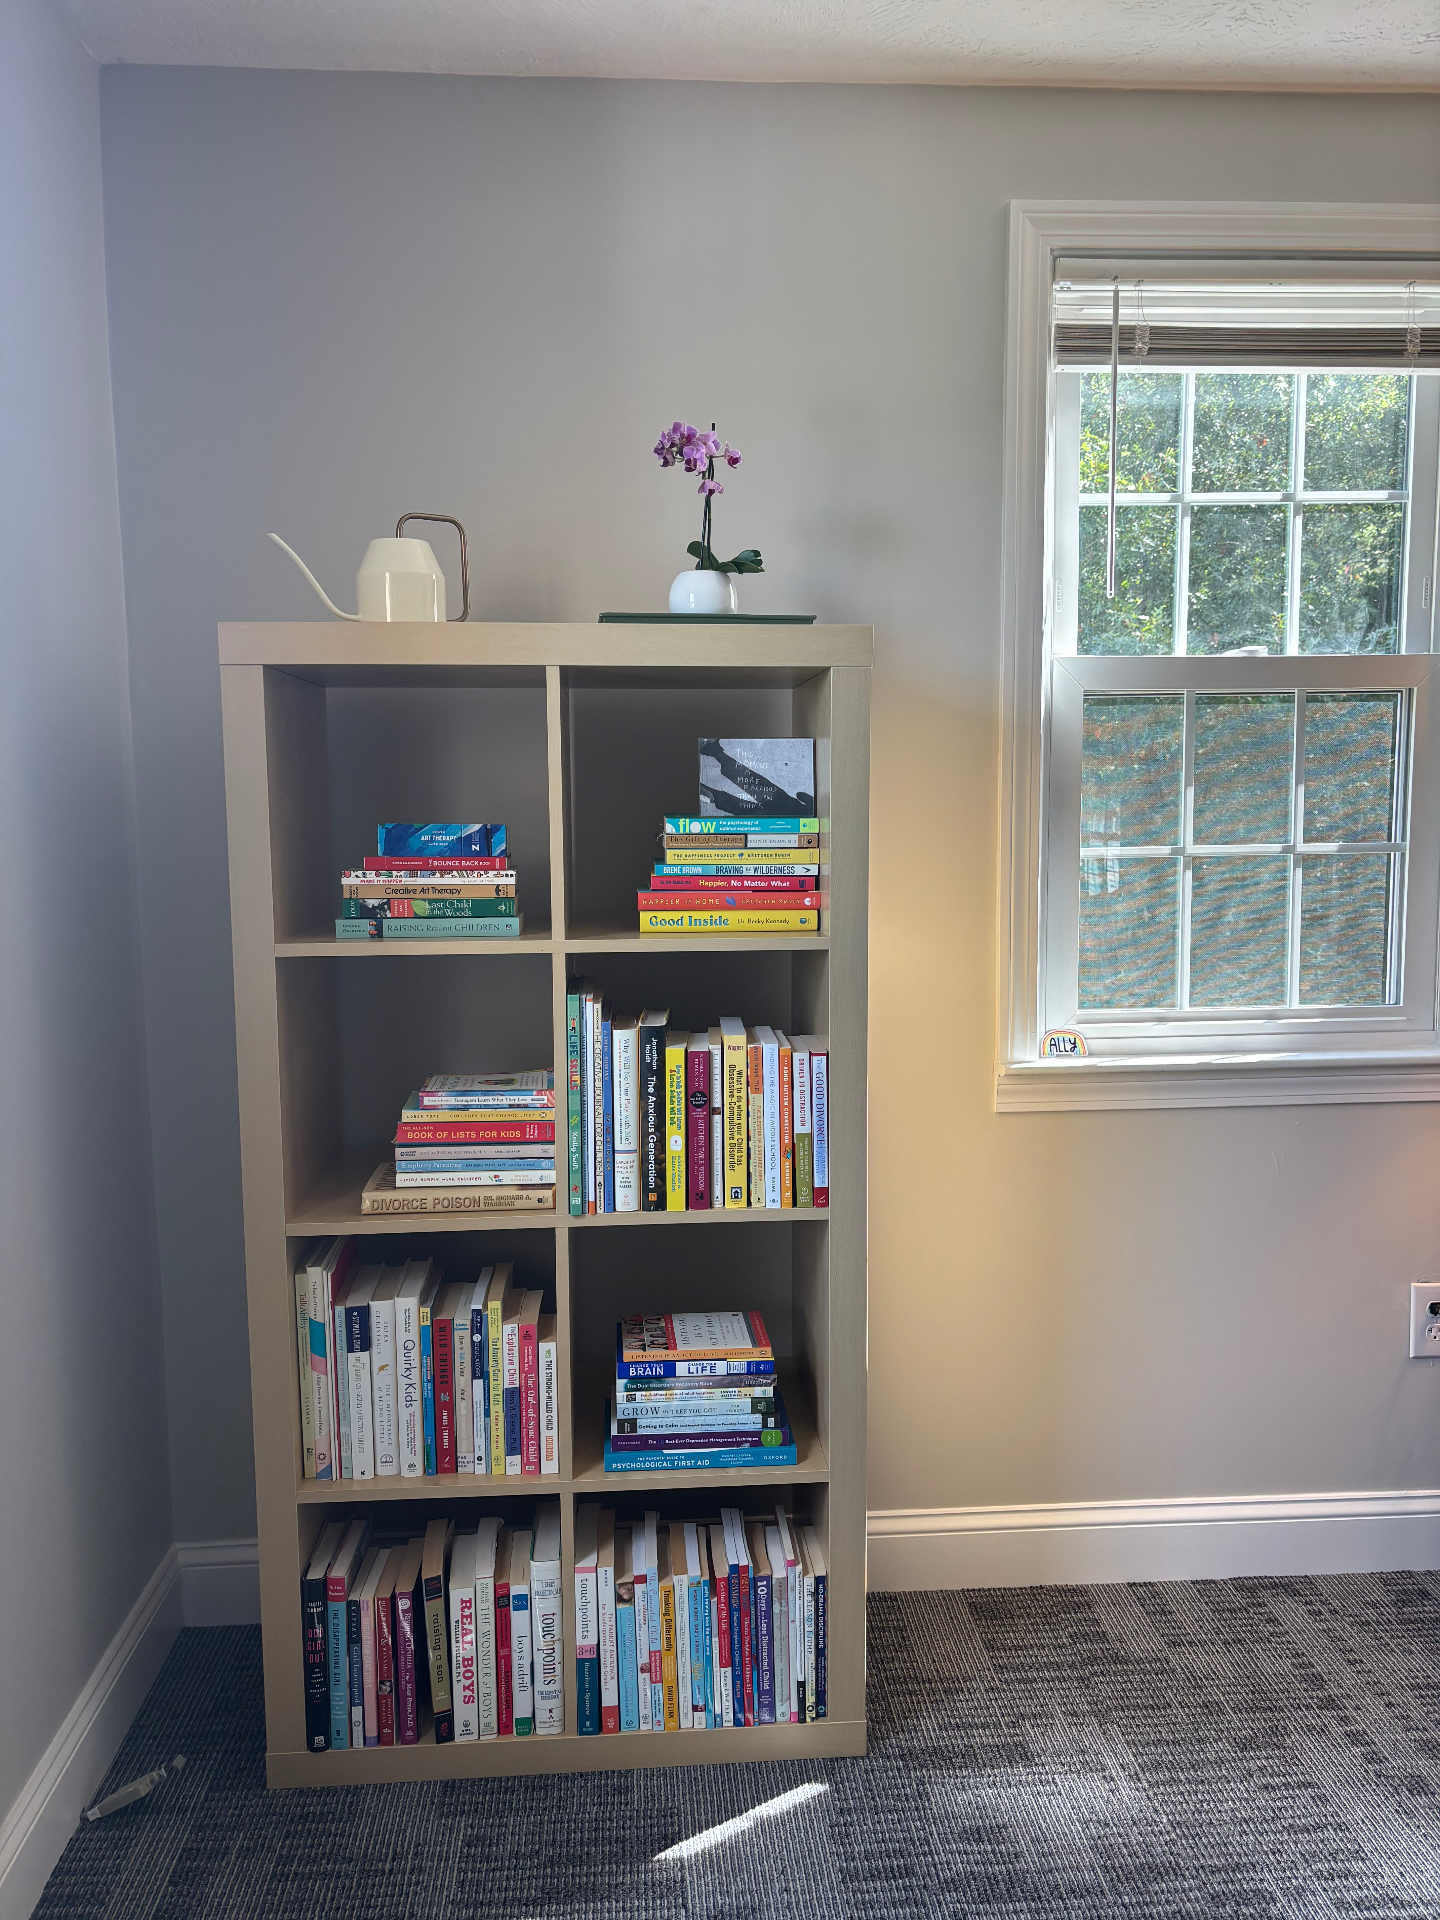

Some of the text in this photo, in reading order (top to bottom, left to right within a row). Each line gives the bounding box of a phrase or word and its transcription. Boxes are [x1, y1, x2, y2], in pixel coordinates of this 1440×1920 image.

[678, 819, 716, 833] flow
[716, 866, 795, 874] BRAVING WILDERNESS
[445, 909, 472, 917] Woods
[447, 900, 472, 908] Child
[455, 924, 500, 932] CHILDREN
[650, 916, 729, 926] Good Inside
[622, 1039, 630, 1053] Why
[569, 1034, 579, 1090] LIFE SKILLS
[624, 1072, 630, 1081] No
[815, 1072, 824, 1100] GOOD
[728, 1064, 737, 1172] Obsessive-Compulsive Disorder
[770, 1111, 776, 1119] IN
[816, 1103, 825, 1145] DIVORCE
[647, 1076, 656, 1188] The Anxious Generation
[735, 1120, 743, 1136] your
[371, 1196, 481, 1212] DIVORCE POISON
[299, 1292, 308, 1330] TalkAbility
[438, 1326, 448, 1385] WILD THINGS
[507, 1333, 516, 1366] Explosive
[401, 1340, 417, 1381] Quirky
[688, 1366, 717, 1375] LIFE
[508, 1369, 517, 1386] Child
[629, 1367, 664, 1376] BRAIN
[404, 1383, 417, 1408] Kids
[526, 1391, 536, 1438] Out-of-Sync
[622, 1407, 660, 1417] GROW
[529, 1441, 537, 1462] Child
[612, 1461, 671, 1469] PSYCHOLOGICAL
[481, 1606, 490, 1625] THE
[579, 1578, 591, 1640] touchpoints
[663, 1590, 673, 1652] Thinking Differently
[308, 1627, 323, 1638] ODD
[432, 1613, 442, 1650] raising
[757, 1580, 767, 1594] 10
[762, 1671, 770, 1689] Child
[307, 1640, 325, 1651] GIRL
[332, 1623, 341, 1671] DISAPPEARING
[460, 1598, 475, 1705] REAL BOYS
[481, 1630, 492, 1677] WONDER
[537, 1612, 561, 1686] touchpoints
[578, 1647, 595, 1655] 3 6
[310, 1652, 324, 1663] OUT
[363, 1640, 371, 1672] CONFIDENT
[514, 1635, 528, 1693] boys adrift
[333, 1672, 341, 1687] GIRL
[364, 1672, 372, 1688] GIRLS
[436, 1664, 444, 1684] son
[482, 1692, 492, 1719] BOYS
